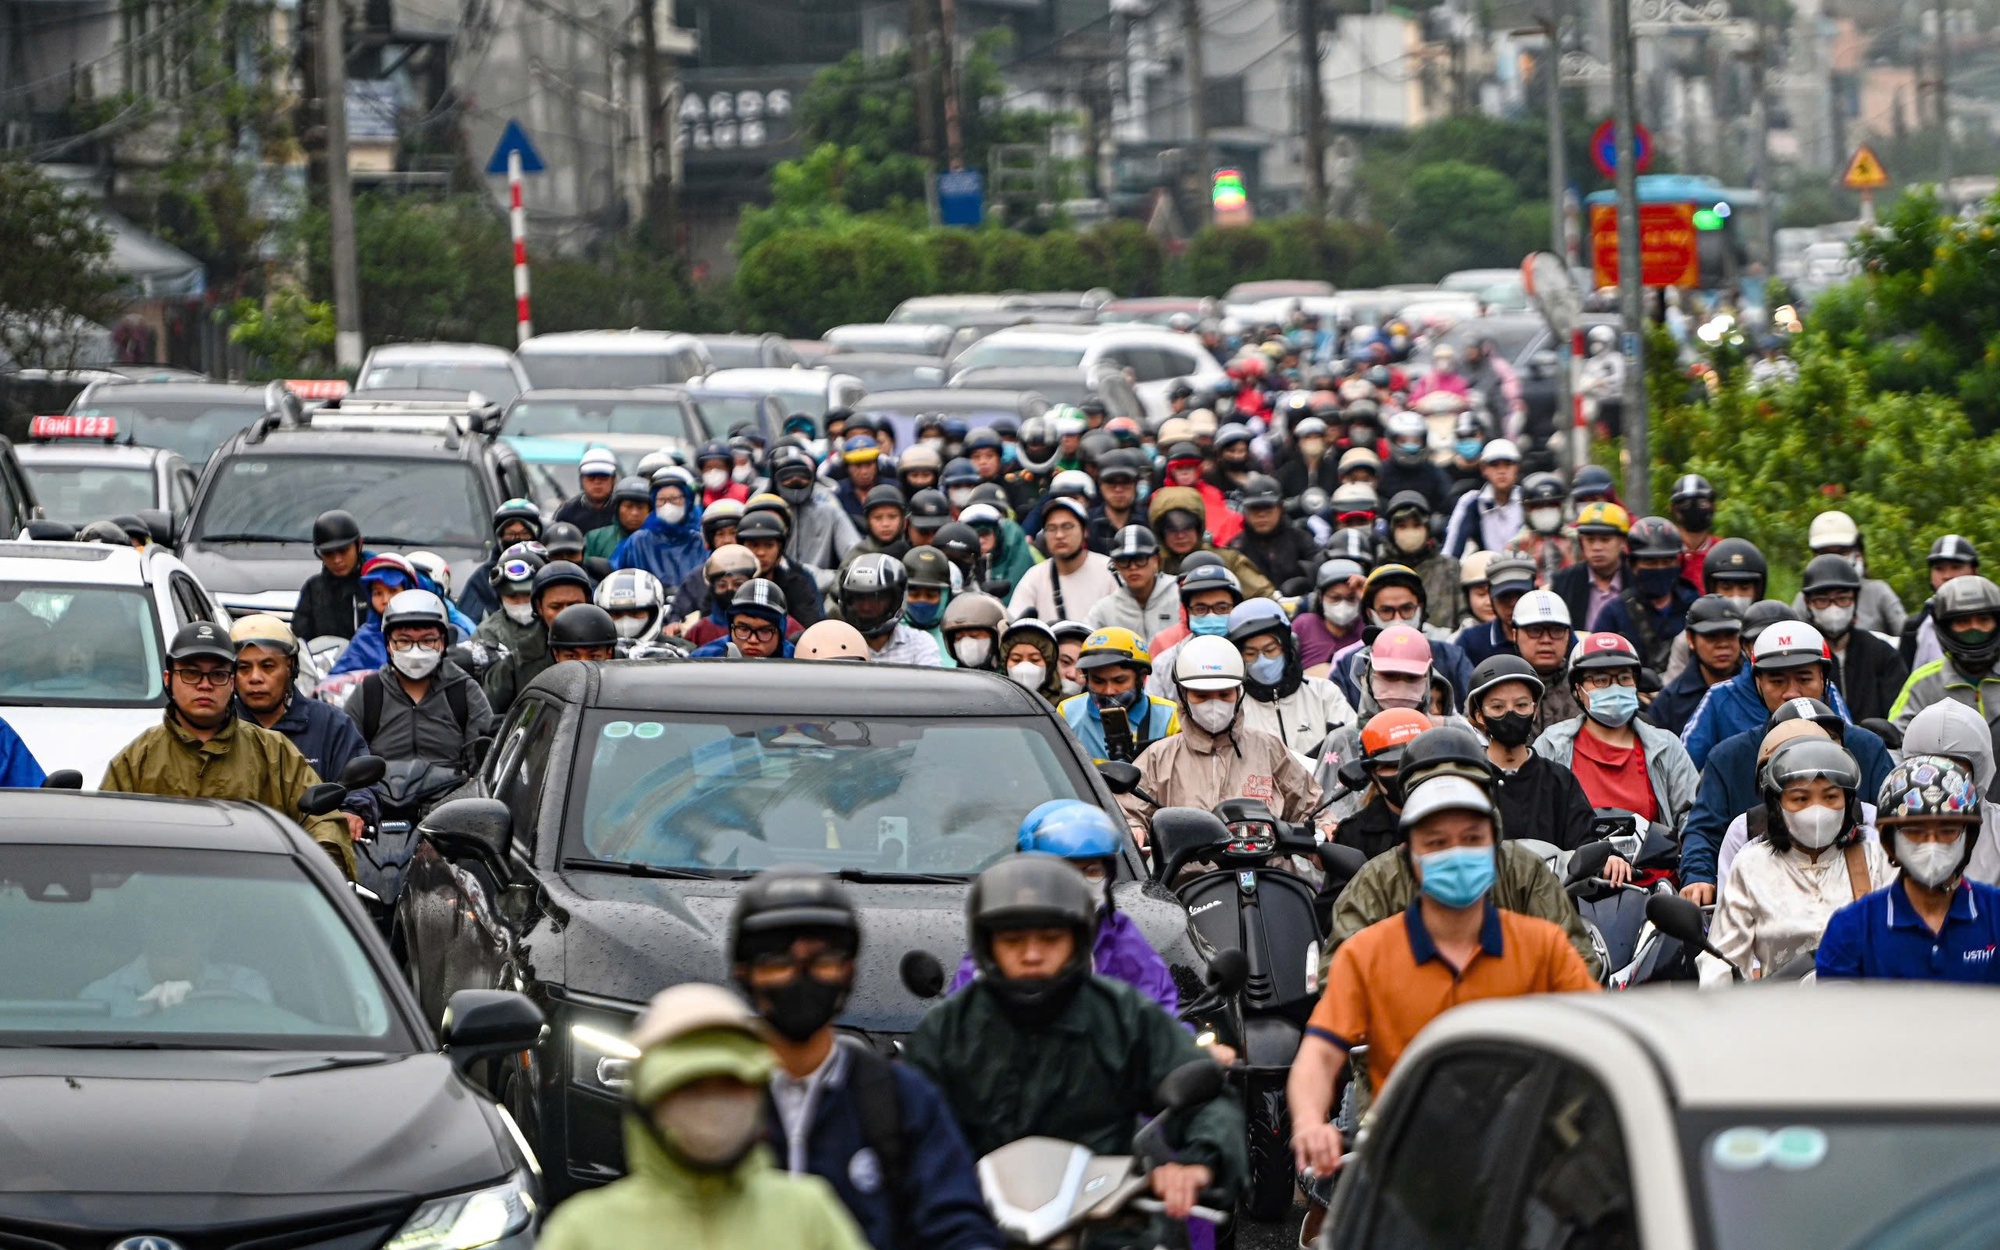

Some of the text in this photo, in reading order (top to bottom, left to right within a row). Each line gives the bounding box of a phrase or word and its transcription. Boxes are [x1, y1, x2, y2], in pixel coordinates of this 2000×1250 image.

[38, 416, 109, 436] Taxi 123
[1778, 636, 1792, 646] M
[1189, 900, 1222, 916] Vespa
[1963, 947, 1991, 961] USTH
